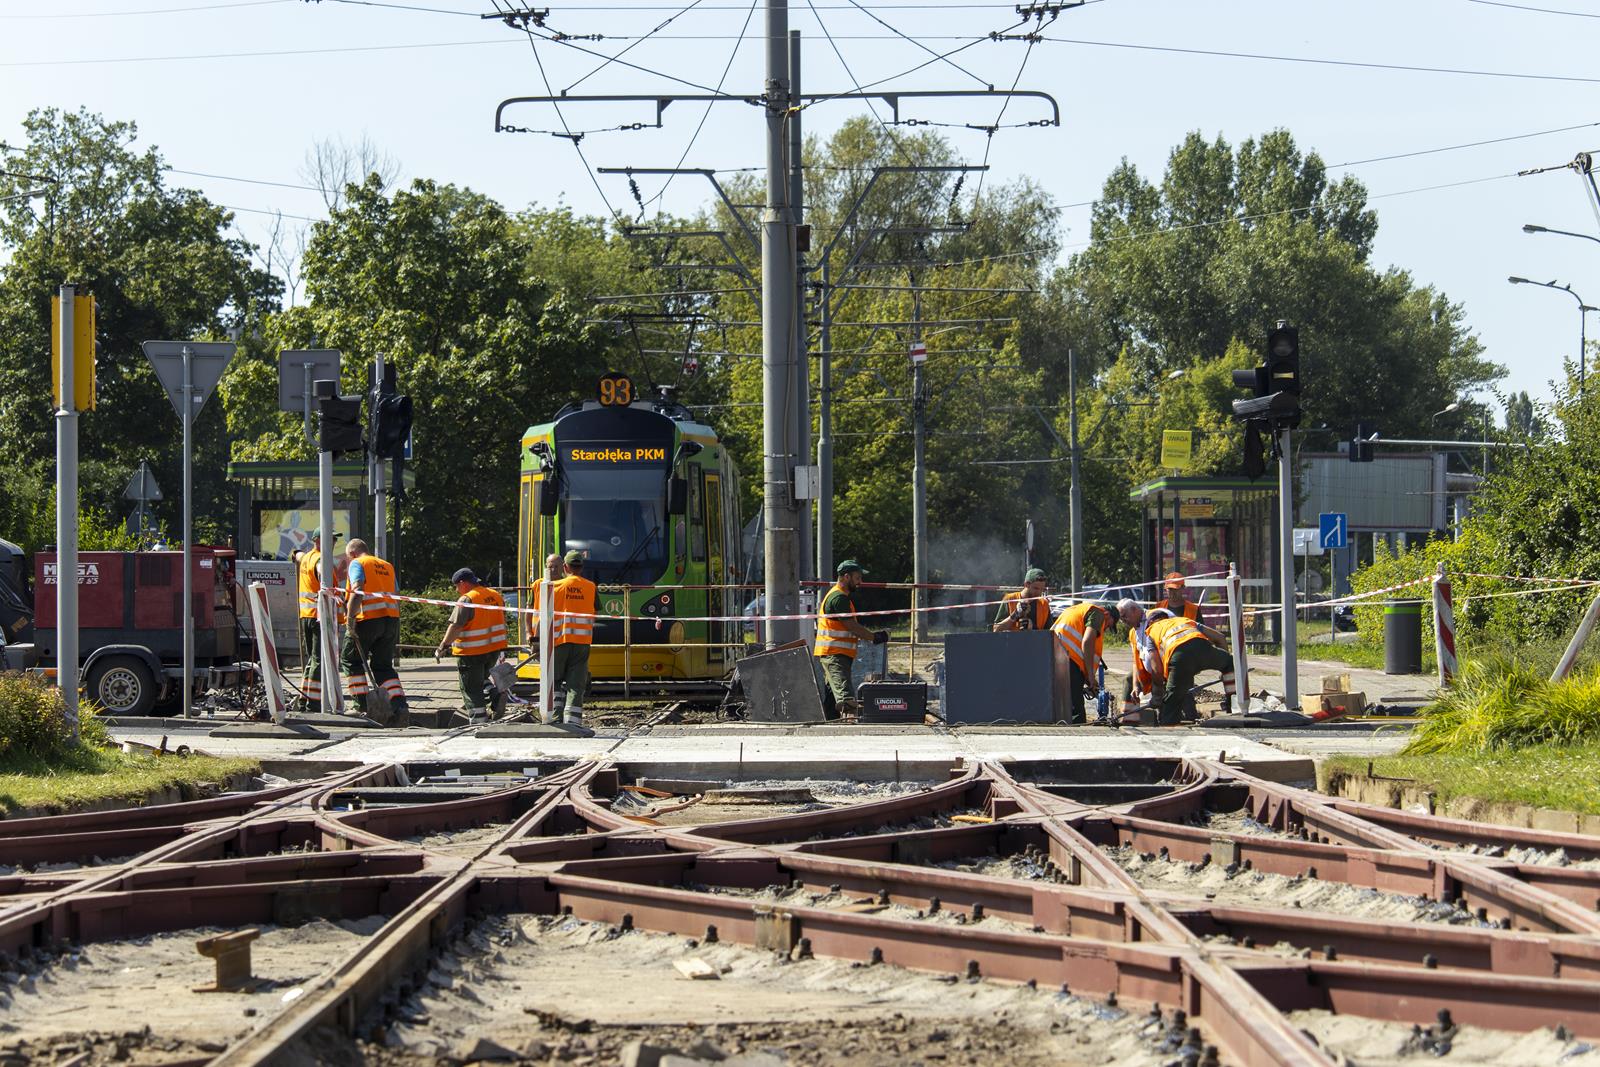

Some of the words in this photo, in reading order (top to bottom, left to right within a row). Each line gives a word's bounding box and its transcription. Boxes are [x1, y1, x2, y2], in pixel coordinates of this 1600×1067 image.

[600, 378, 631, 405] 93
[571, 449, 632, 463] Starołęka
[636, 449, 665, 460] PKM
[566, 587, 582, 595] MPK
